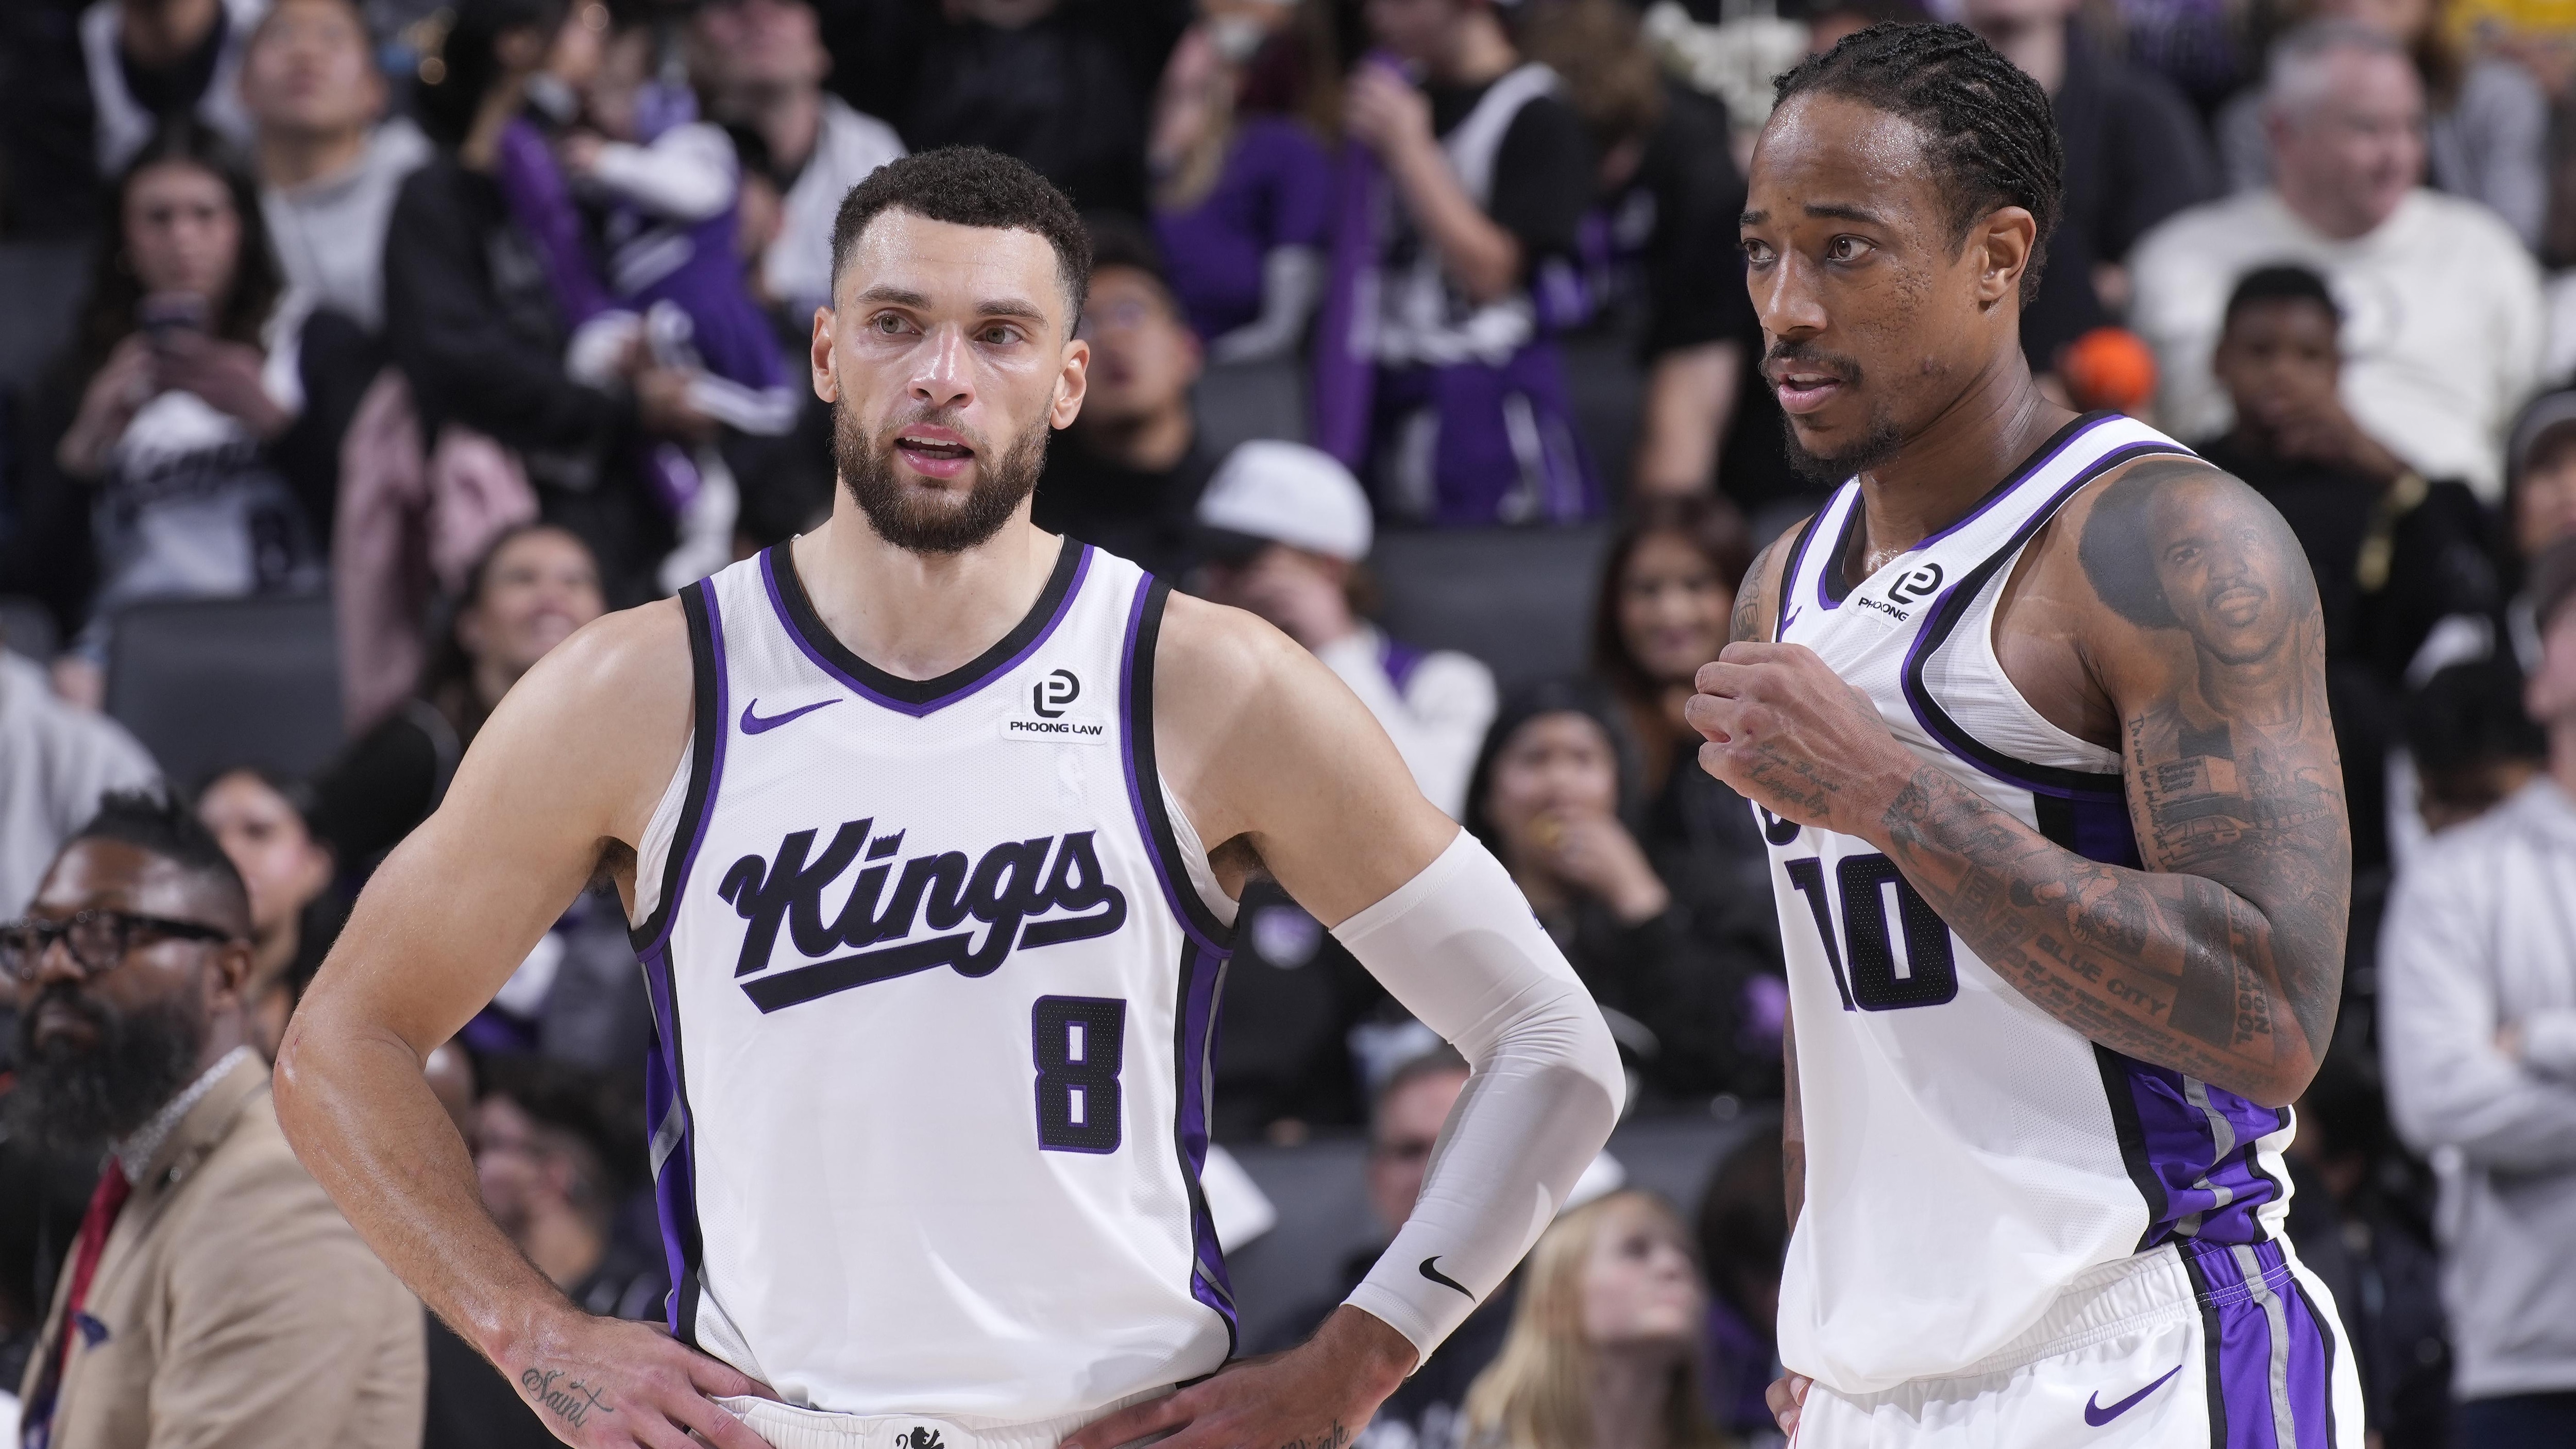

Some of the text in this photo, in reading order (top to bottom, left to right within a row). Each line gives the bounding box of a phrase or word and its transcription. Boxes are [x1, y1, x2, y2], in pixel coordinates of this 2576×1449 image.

[1010, 722, 1103, 735] PHOONG LAW
[718, 817, 1127, 1014] Kings
[1784, 853, 1958, 1013] 10
[2036, 932, 2103, 984] BLUE
[2107, 979, 2167, 1016] CITY
[1032, 995, 1127, 1155] 8
[522, 1368, 614, 1428] Saint
